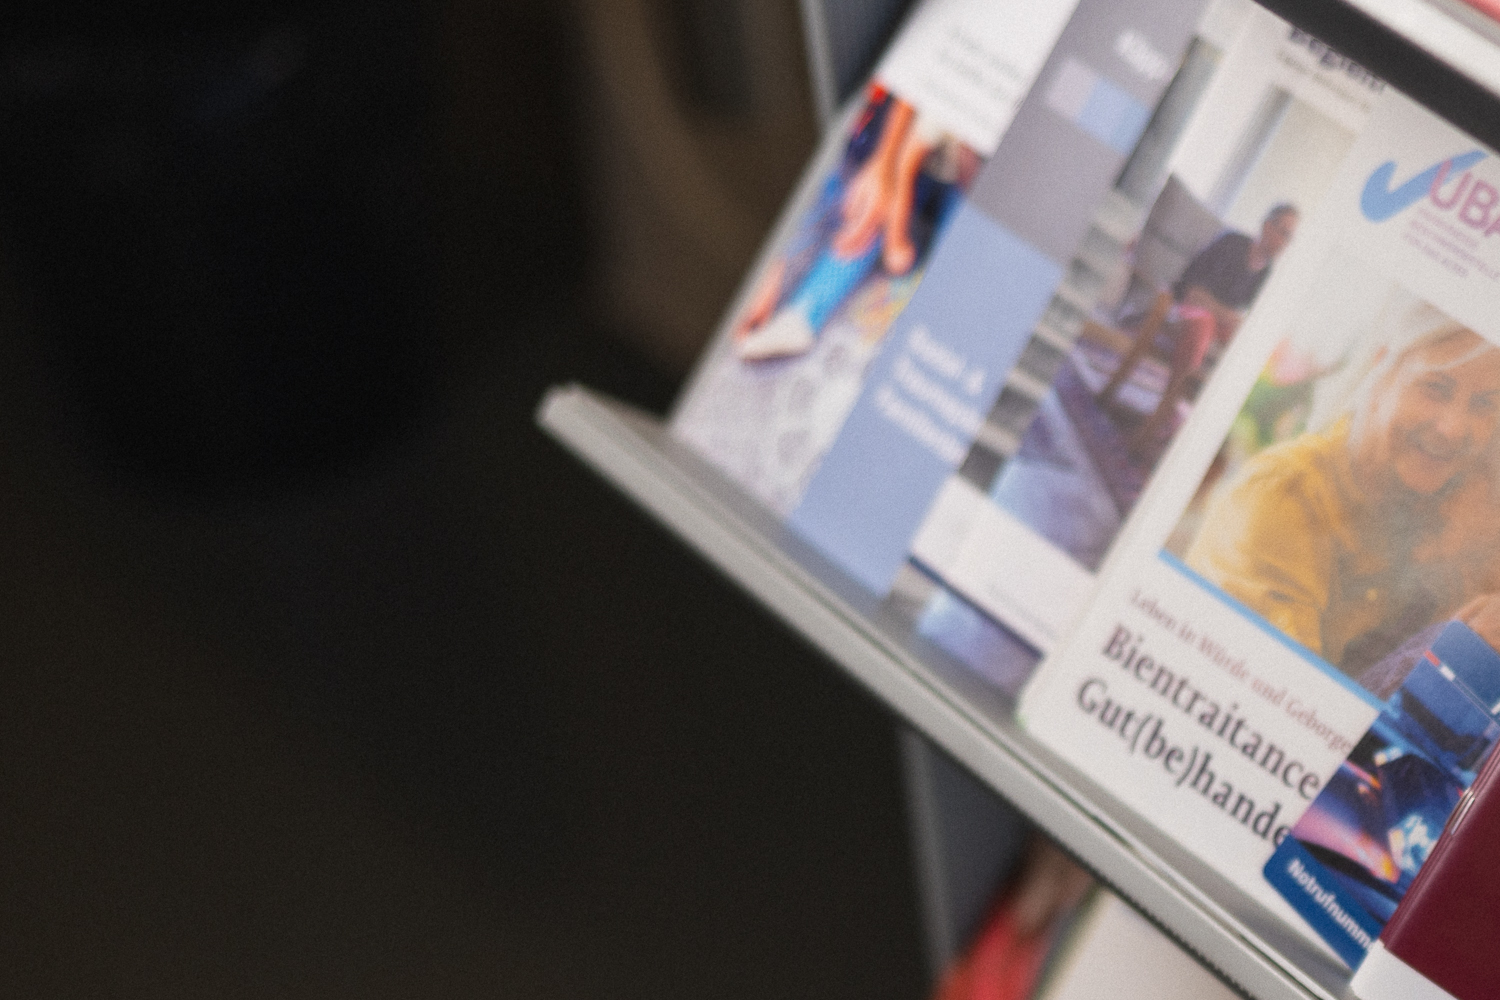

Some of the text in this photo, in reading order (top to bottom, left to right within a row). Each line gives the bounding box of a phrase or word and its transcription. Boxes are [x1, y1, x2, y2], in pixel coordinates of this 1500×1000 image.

[1103, 623, 1321, 800] Bientraitance
[1178, 620, 1198, 644] in
[1251, 676, 1289, 707] und
